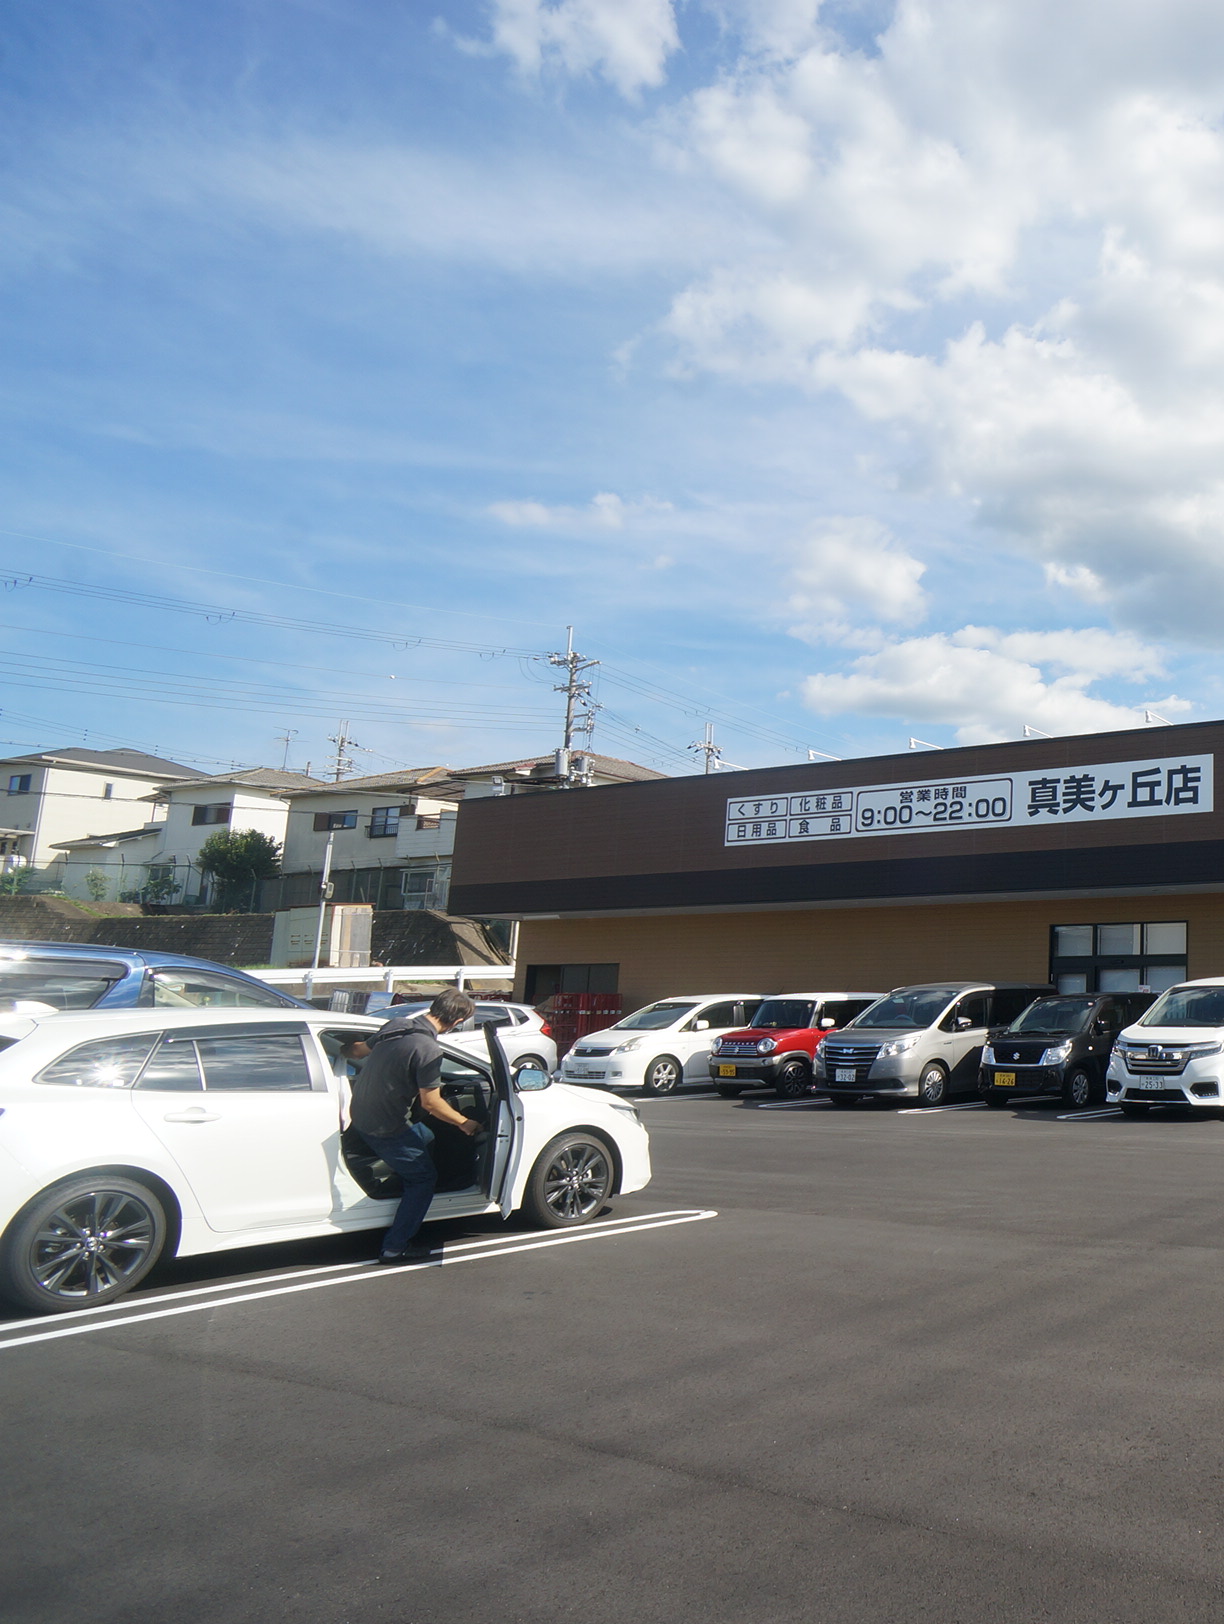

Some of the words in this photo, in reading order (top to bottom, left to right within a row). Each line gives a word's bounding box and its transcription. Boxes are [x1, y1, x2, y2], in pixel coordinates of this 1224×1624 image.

[900, 786, 967, 804] 営業時間
[1027, 765, 1201, 817] 真美ヶ丘店
[738, 801, 779, 816] くすり
[799, 795, 842, 812] 化粧品
[737, 823, 777, 838] 日用品
